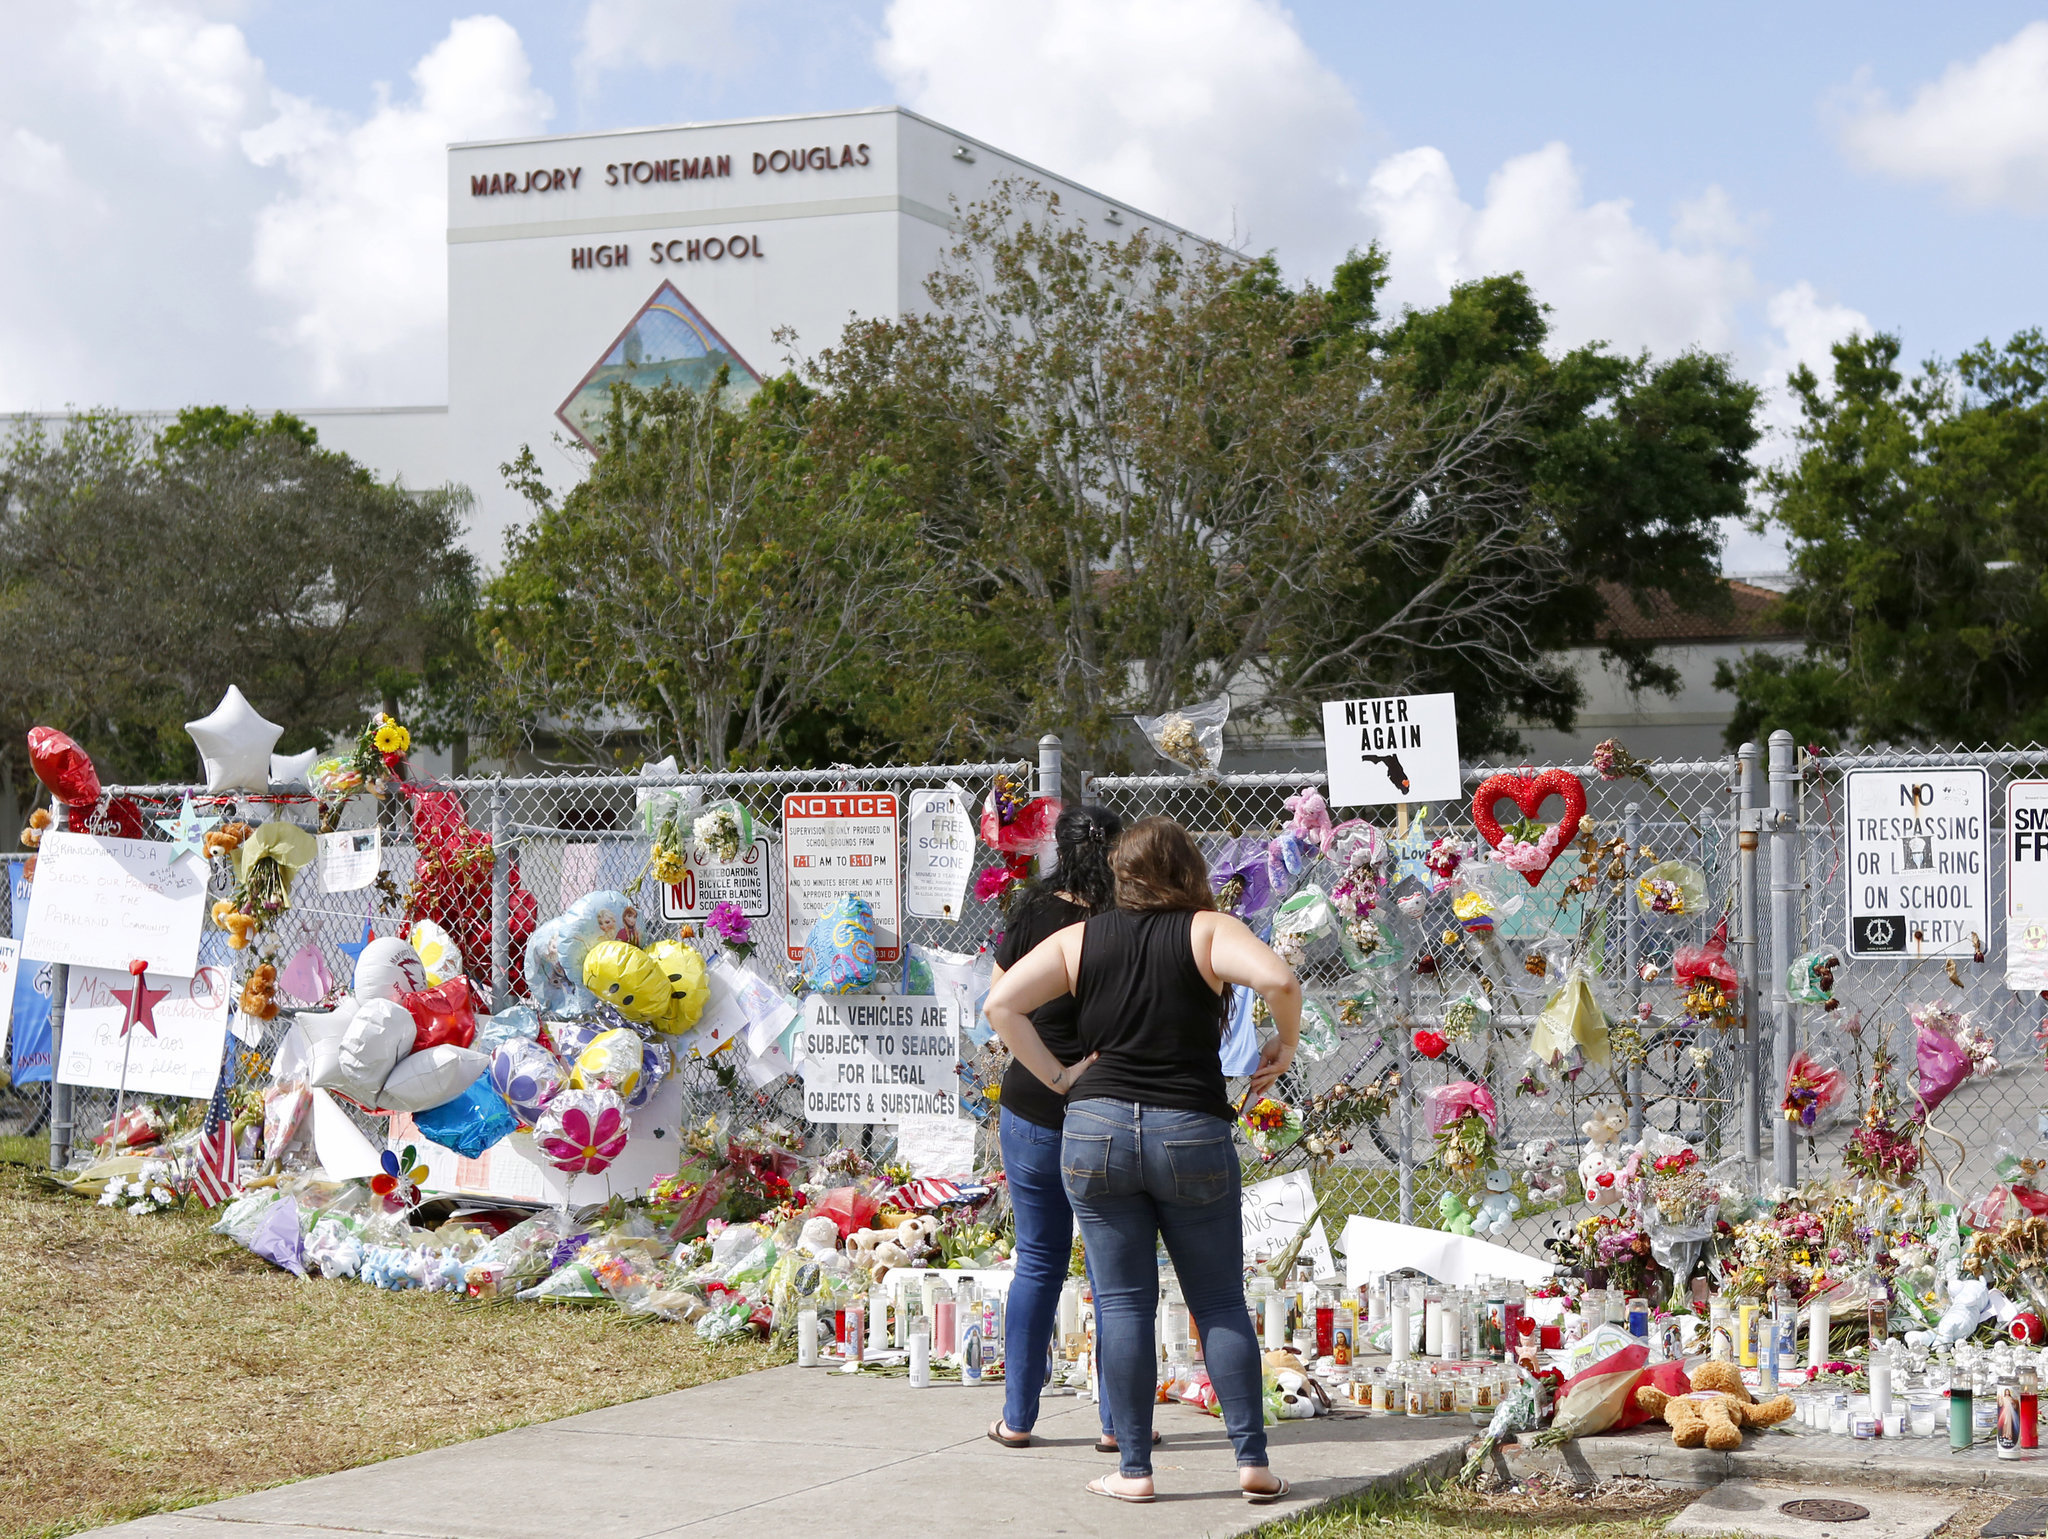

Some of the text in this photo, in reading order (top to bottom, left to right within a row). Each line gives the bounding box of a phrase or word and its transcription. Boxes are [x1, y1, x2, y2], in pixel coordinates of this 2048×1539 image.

[471, 143, 871, 196] MARJORY STONEMAN DOUGLAS
[571, 234, 764, 270] HIGH SCHOOL
[1345, 699, 1408, 725] NEVER
[1361, 724, 1421, 751] AGAIN
[1900, 783, 1934, 806] NO
[789, 798, 892, 815] NOTICE
[926, 802, 962, 814] DRUG
[931, 819, 964, 832] FREE
[1857, 816, 1979, 841] TRESPASSING
[2015, 808, 2048, 830] SM
[789, 825, 890, 835] SUPERVISION IS ONLY PROVIDED ON
[806, 838, 874, 847] SCHOOL GROUNDS FROM
[919, 837, 969, 852] SCHOOL
[2015, 833, 2048, 862] FR
[819, 857, 832, 866] AM
[836, 857, 847, 866] TO
[851, 855, 870, 866] 3:10
[874, 855, 886, 865] PM
[928, 856, 963, 869] ZONE
[1858, 851, 1979, 875] OR LRING
[48, 867, 88, 884] SENDS
[97, 876, 119, 886] OUR
[698, 867, 758, 878] SKATEBOARDING
[789, 879, 801, 887] AND
[813, 879, 836, 887] MINUTES
[671, 869, 695, 910] NO
[699, 878, 761, 889] BICYCLE RIDING
[119, 895, 141, 906] THE
[699, 889, 762, 900] ROLLER BLADING
[1864, 885, 1973, 909] ON SCHOOL
[44, 904, 109, 928] PARKLAND
[816, 1005, 947, 1026] ALL VEHICLES ARE
[808, 1034, 955, 1056] SUBJECT TO SEARCH
[838, 1063, 925, 1084] FOR ILLEGAL
[808, 1092, 955, 1115] OBJECTS & SUBSTANCES
[1303, 1246, 1324, 1257] ays
